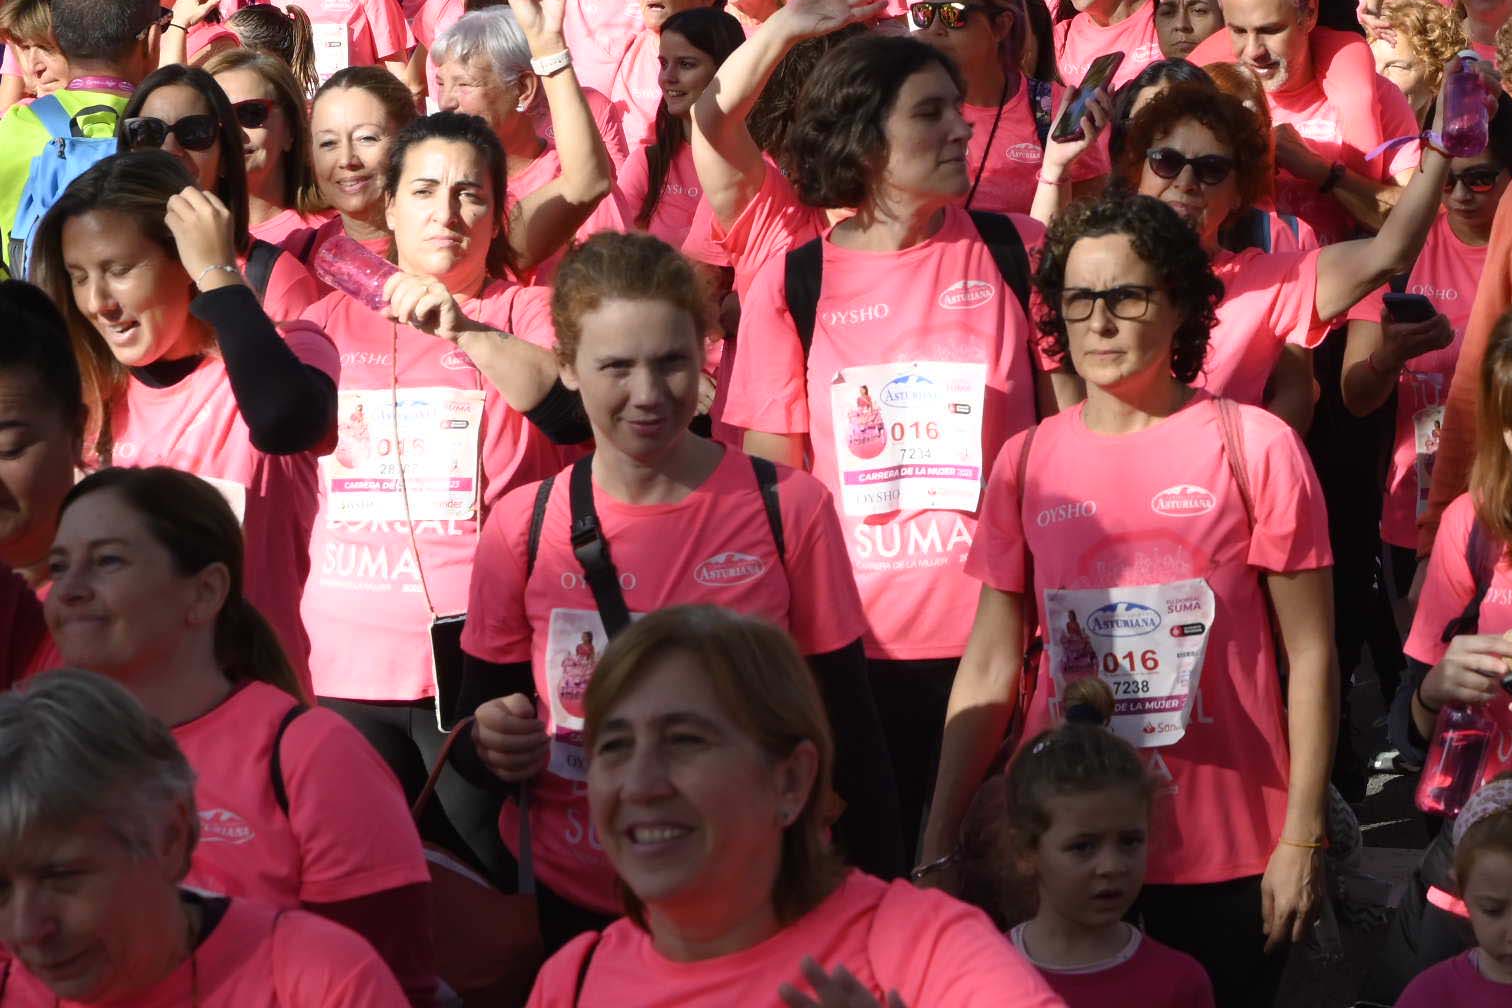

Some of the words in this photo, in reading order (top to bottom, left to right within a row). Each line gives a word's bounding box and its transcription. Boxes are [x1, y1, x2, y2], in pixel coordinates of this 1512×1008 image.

[822, 303, 889, 325] OYSHO
[890, 421, 939, 442] 016
[858, 468, 900, 482] CARRERA
[901, 467, 914, 476] DE
[915, 466, 927, 476] LA
[1157, 498, 1212, 510] ASTURIANA
[1036, 500, 1097, 528] OYSHO
[853, 516, 973, 559] SUMA
[322, 542, 420, 581] SUMA
[1167, 601, 1201, 615] SUMA
[1091, 615, 1157, 631] ASTURIANA
[1102, 649, 1160, 674] 016
[1113, 679, 1150, 695] 7238
[1115, 701, 1129, 713] DE
[1130, 700, 1143, 711] LA
[1145, 698, 1179, 710] MUJER
